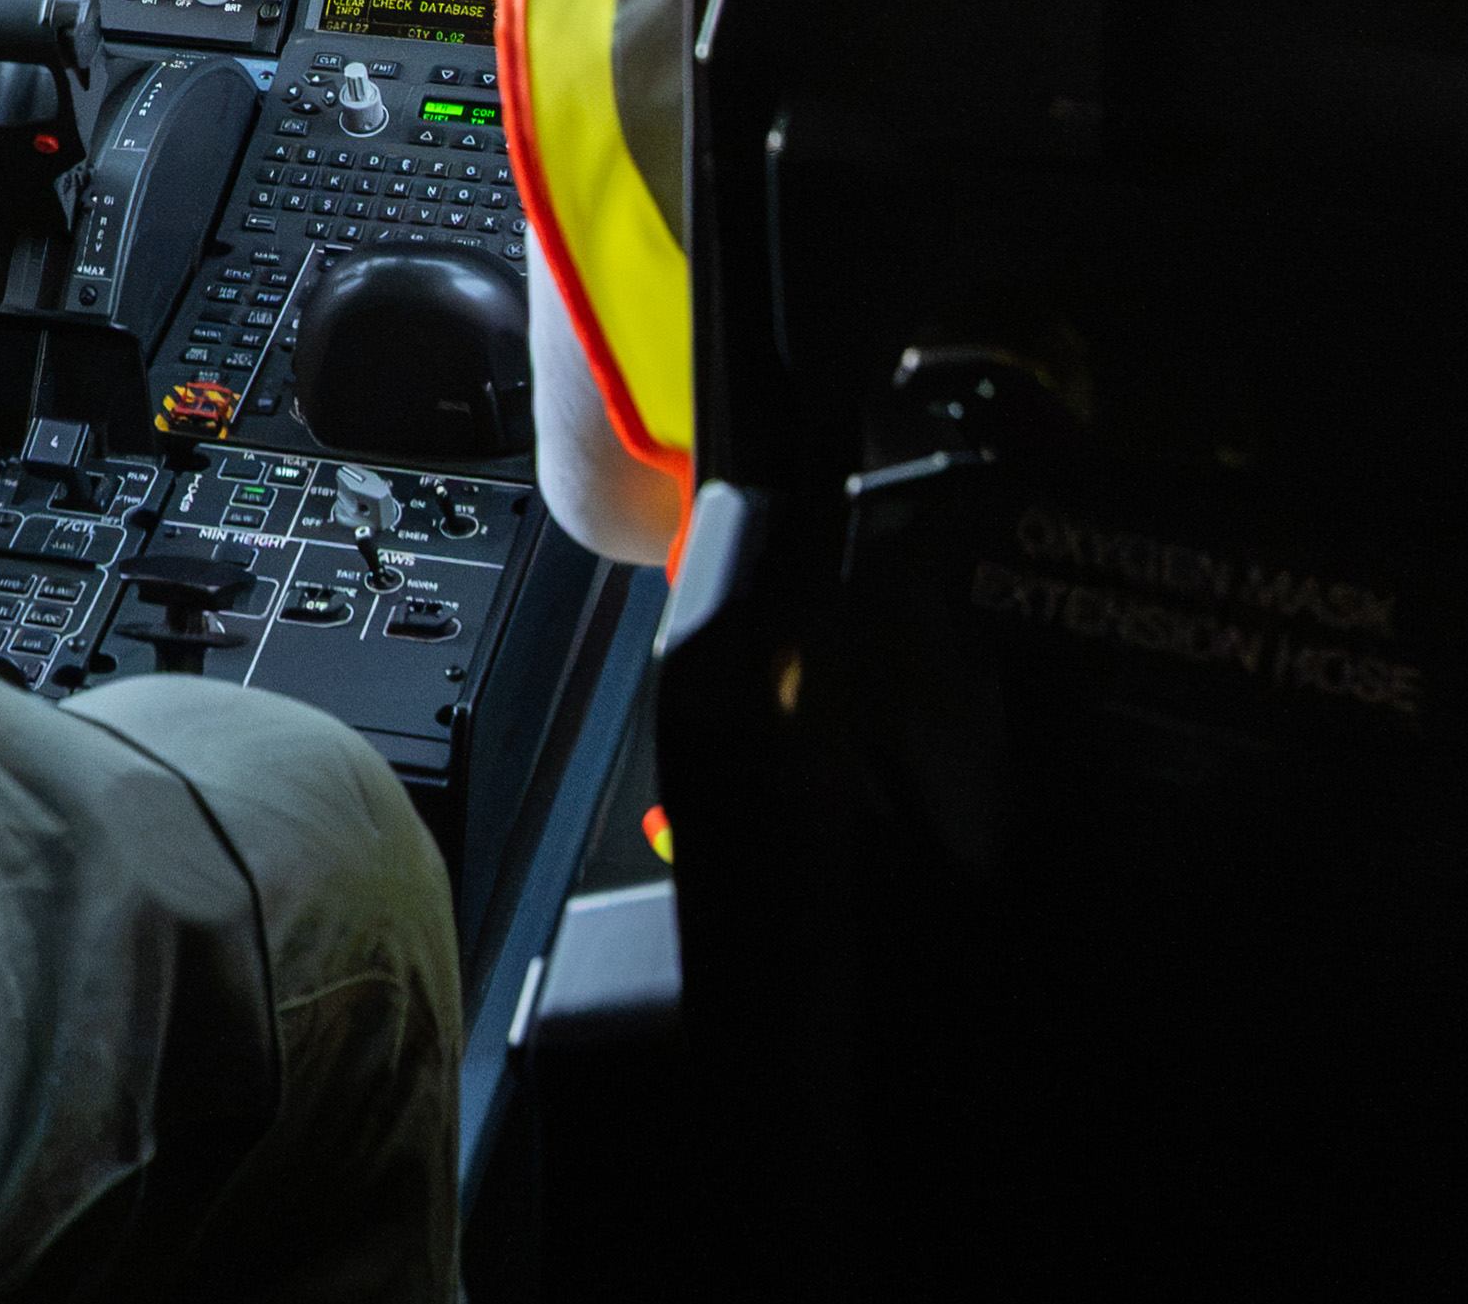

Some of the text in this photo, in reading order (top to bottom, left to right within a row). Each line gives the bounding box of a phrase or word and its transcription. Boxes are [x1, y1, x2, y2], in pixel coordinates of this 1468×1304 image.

[419, 0, 486, 19] DATABASE
[200, 528, 288, 550] MIN HEIGHT
[1017, 510, 1398, 638] OXYGEN MASK
[971, 560, 1422, 716] EXTENSION HOSE
